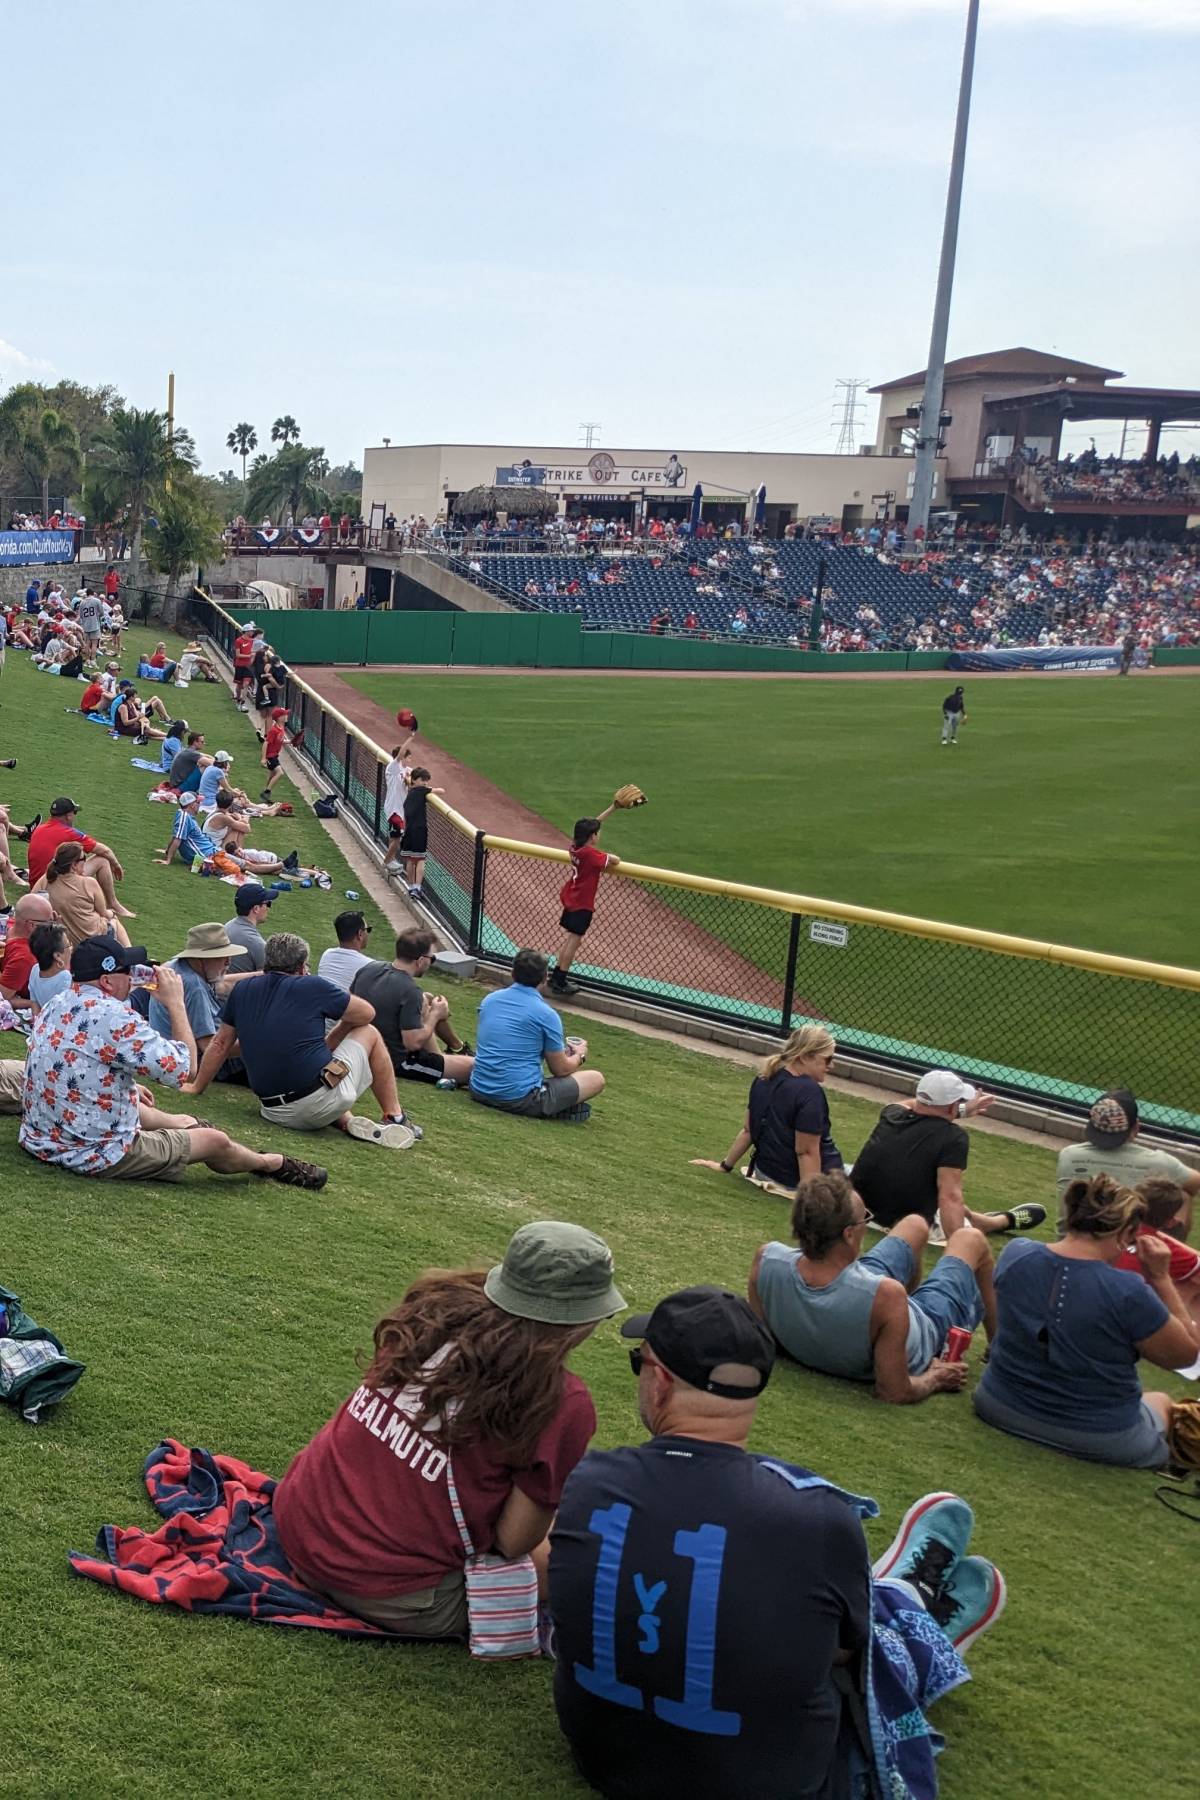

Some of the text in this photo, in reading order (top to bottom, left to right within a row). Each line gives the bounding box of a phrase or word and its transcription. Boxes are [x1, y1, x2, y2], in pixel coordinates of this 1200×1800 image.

[539, 470, 661, 481] STRIKE OUT CAFE
[83, 606, 95, 618] 28
[346, 1384, 448, 1482] REALMUTO
